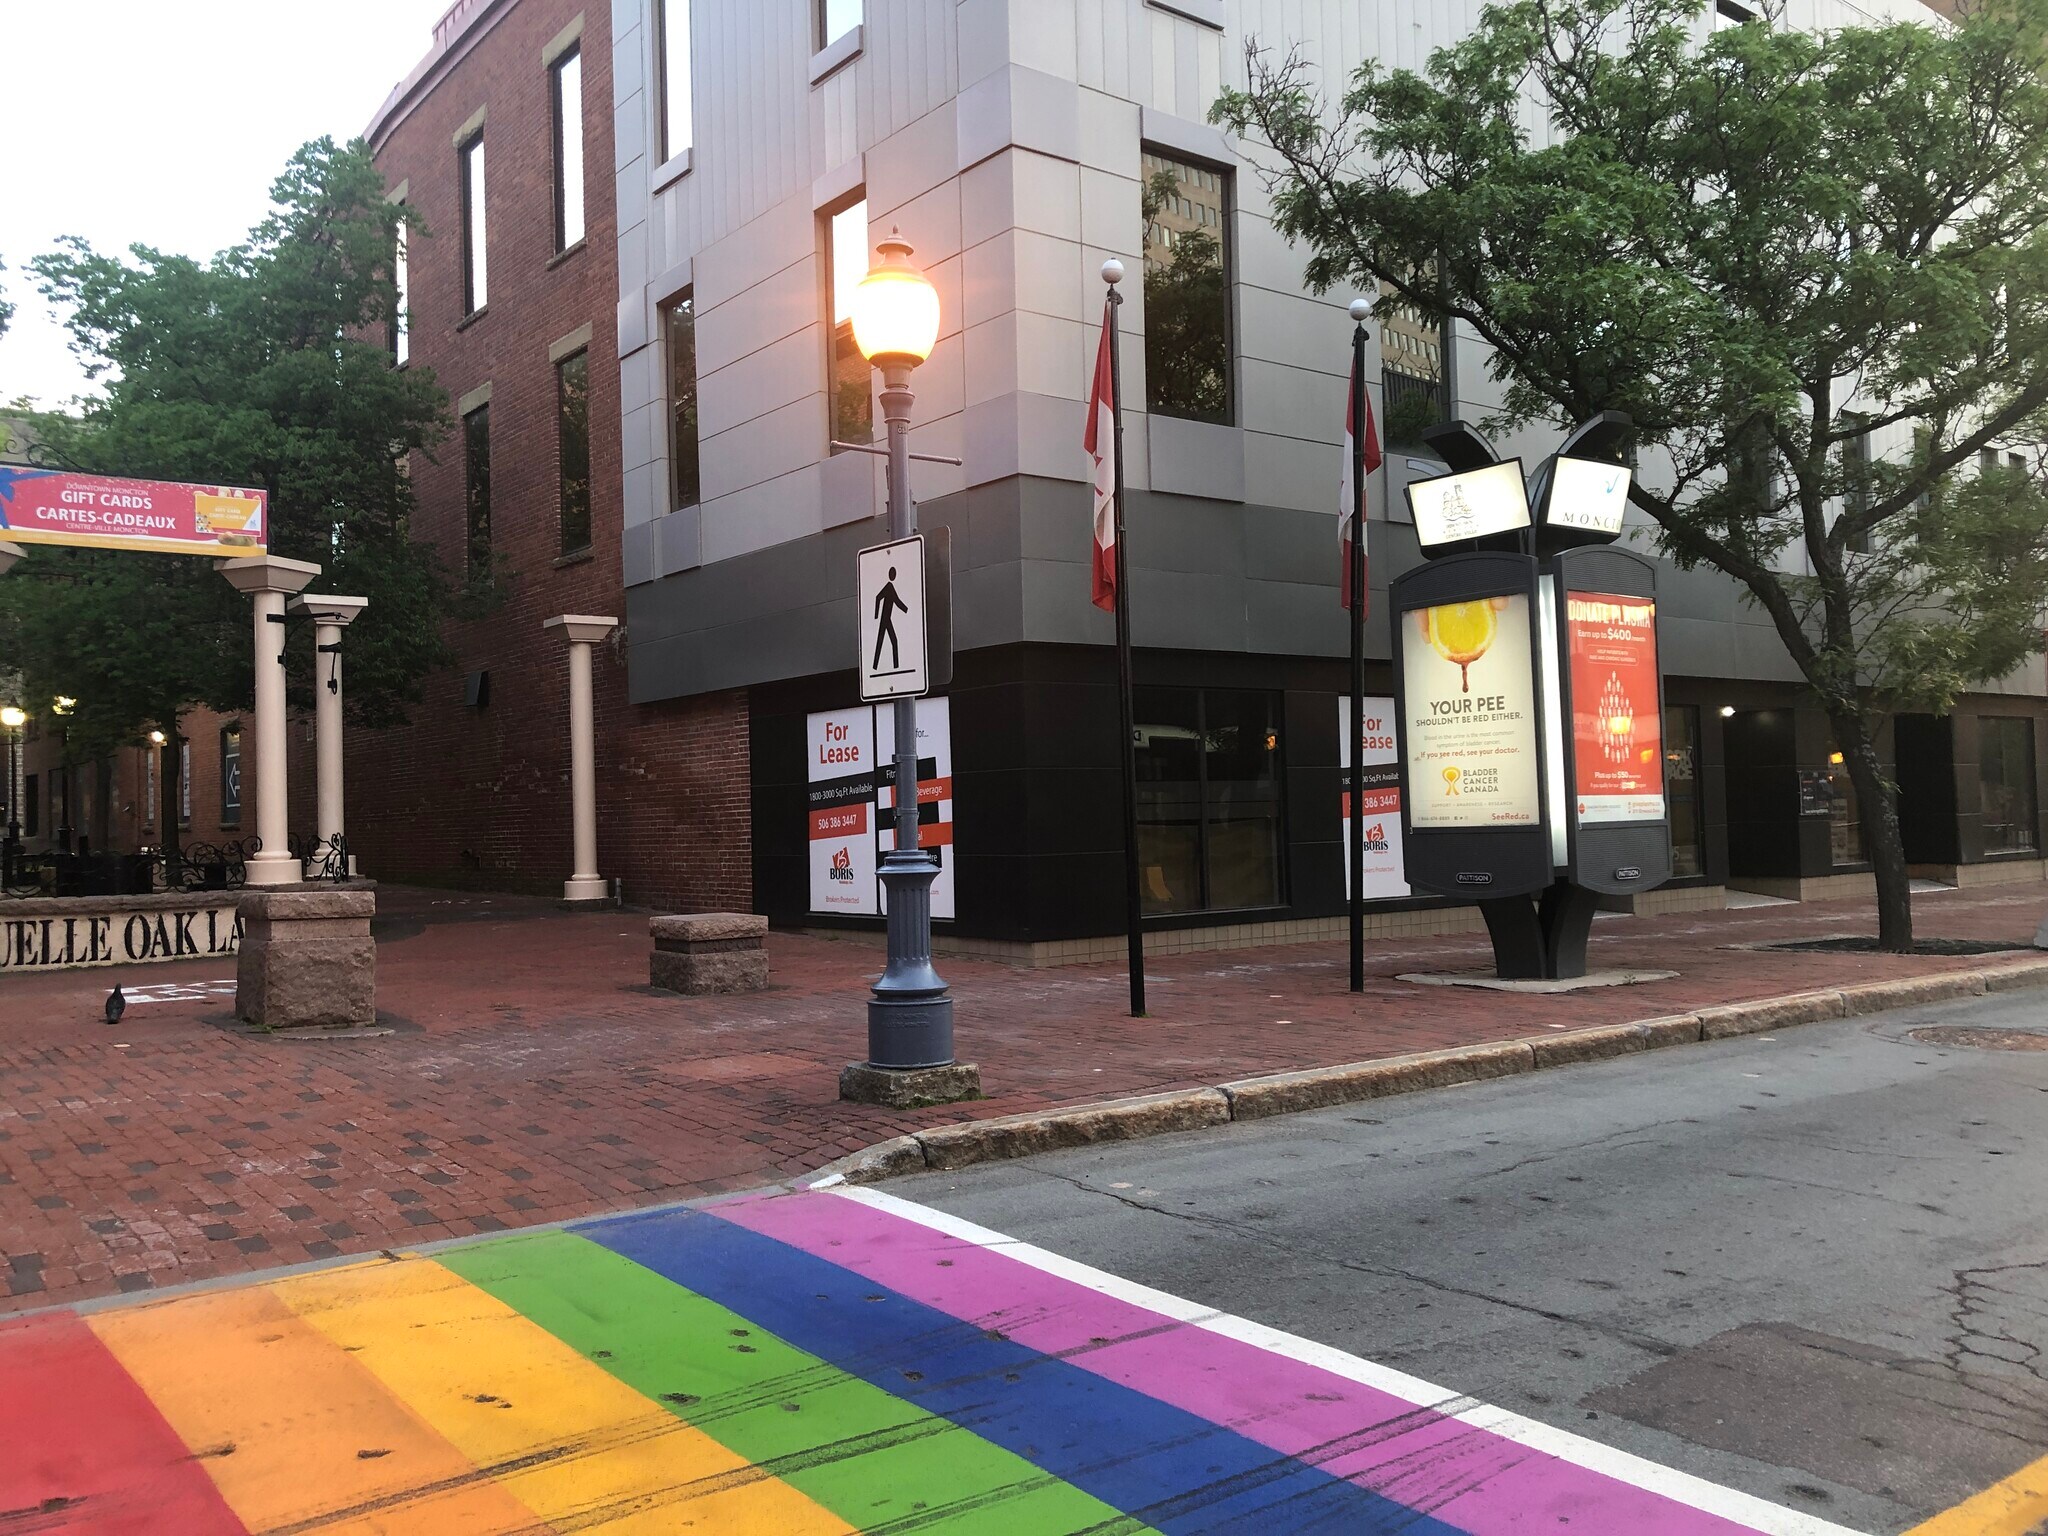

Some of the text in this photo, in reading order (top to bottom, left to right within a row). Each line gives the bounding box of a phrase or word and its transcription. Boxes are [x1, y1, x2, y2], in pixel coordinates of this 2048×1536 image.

[66, 482, 148, 496] DOWNTOWN MONCTON
[61, 490, 152, 510] GIFT CARDS
[36, 507, 176, 529] CARTES-CADEAUX
[66, 523, 148, 534] CENTRE-VILLE MONCTON
[1430, 695, 1505, 715] YOUR PEE
[1416, 717, 1459, 726] SHOULDN'T
[1473, 714, 1489, 722] RED
[1491, 711, 1523, 721] EITHER.
[826, 722, 848, 742] For
[1362, 736, 1393, 749] ease
[820, 744, 859, 764] Lease
[1451, 749, 1465, 757] red,
[1479, 749, 1493, 757] your
[1463, 767, 1498, 777] BLADDER
[1463, 776, 1498, 785] CANCER
[809, 789, 835, 801] 1800-3000
[849, 782, 873, 795] Available
[1463, 785, 1499, 793] CANADA
[1364, 795, 1397, 809] 386 3447
[818, 814, 857, 830] 506 386 3447
[1492, 812, 1530, 821] SeeRed.ca
[1363, 840, 1389, 851] BORIS
[830, 868, 854, 880] BORIS
[1458, 874, 1489, 882] PATTISON
[1618, 869, 1639, 877] PATTISON
